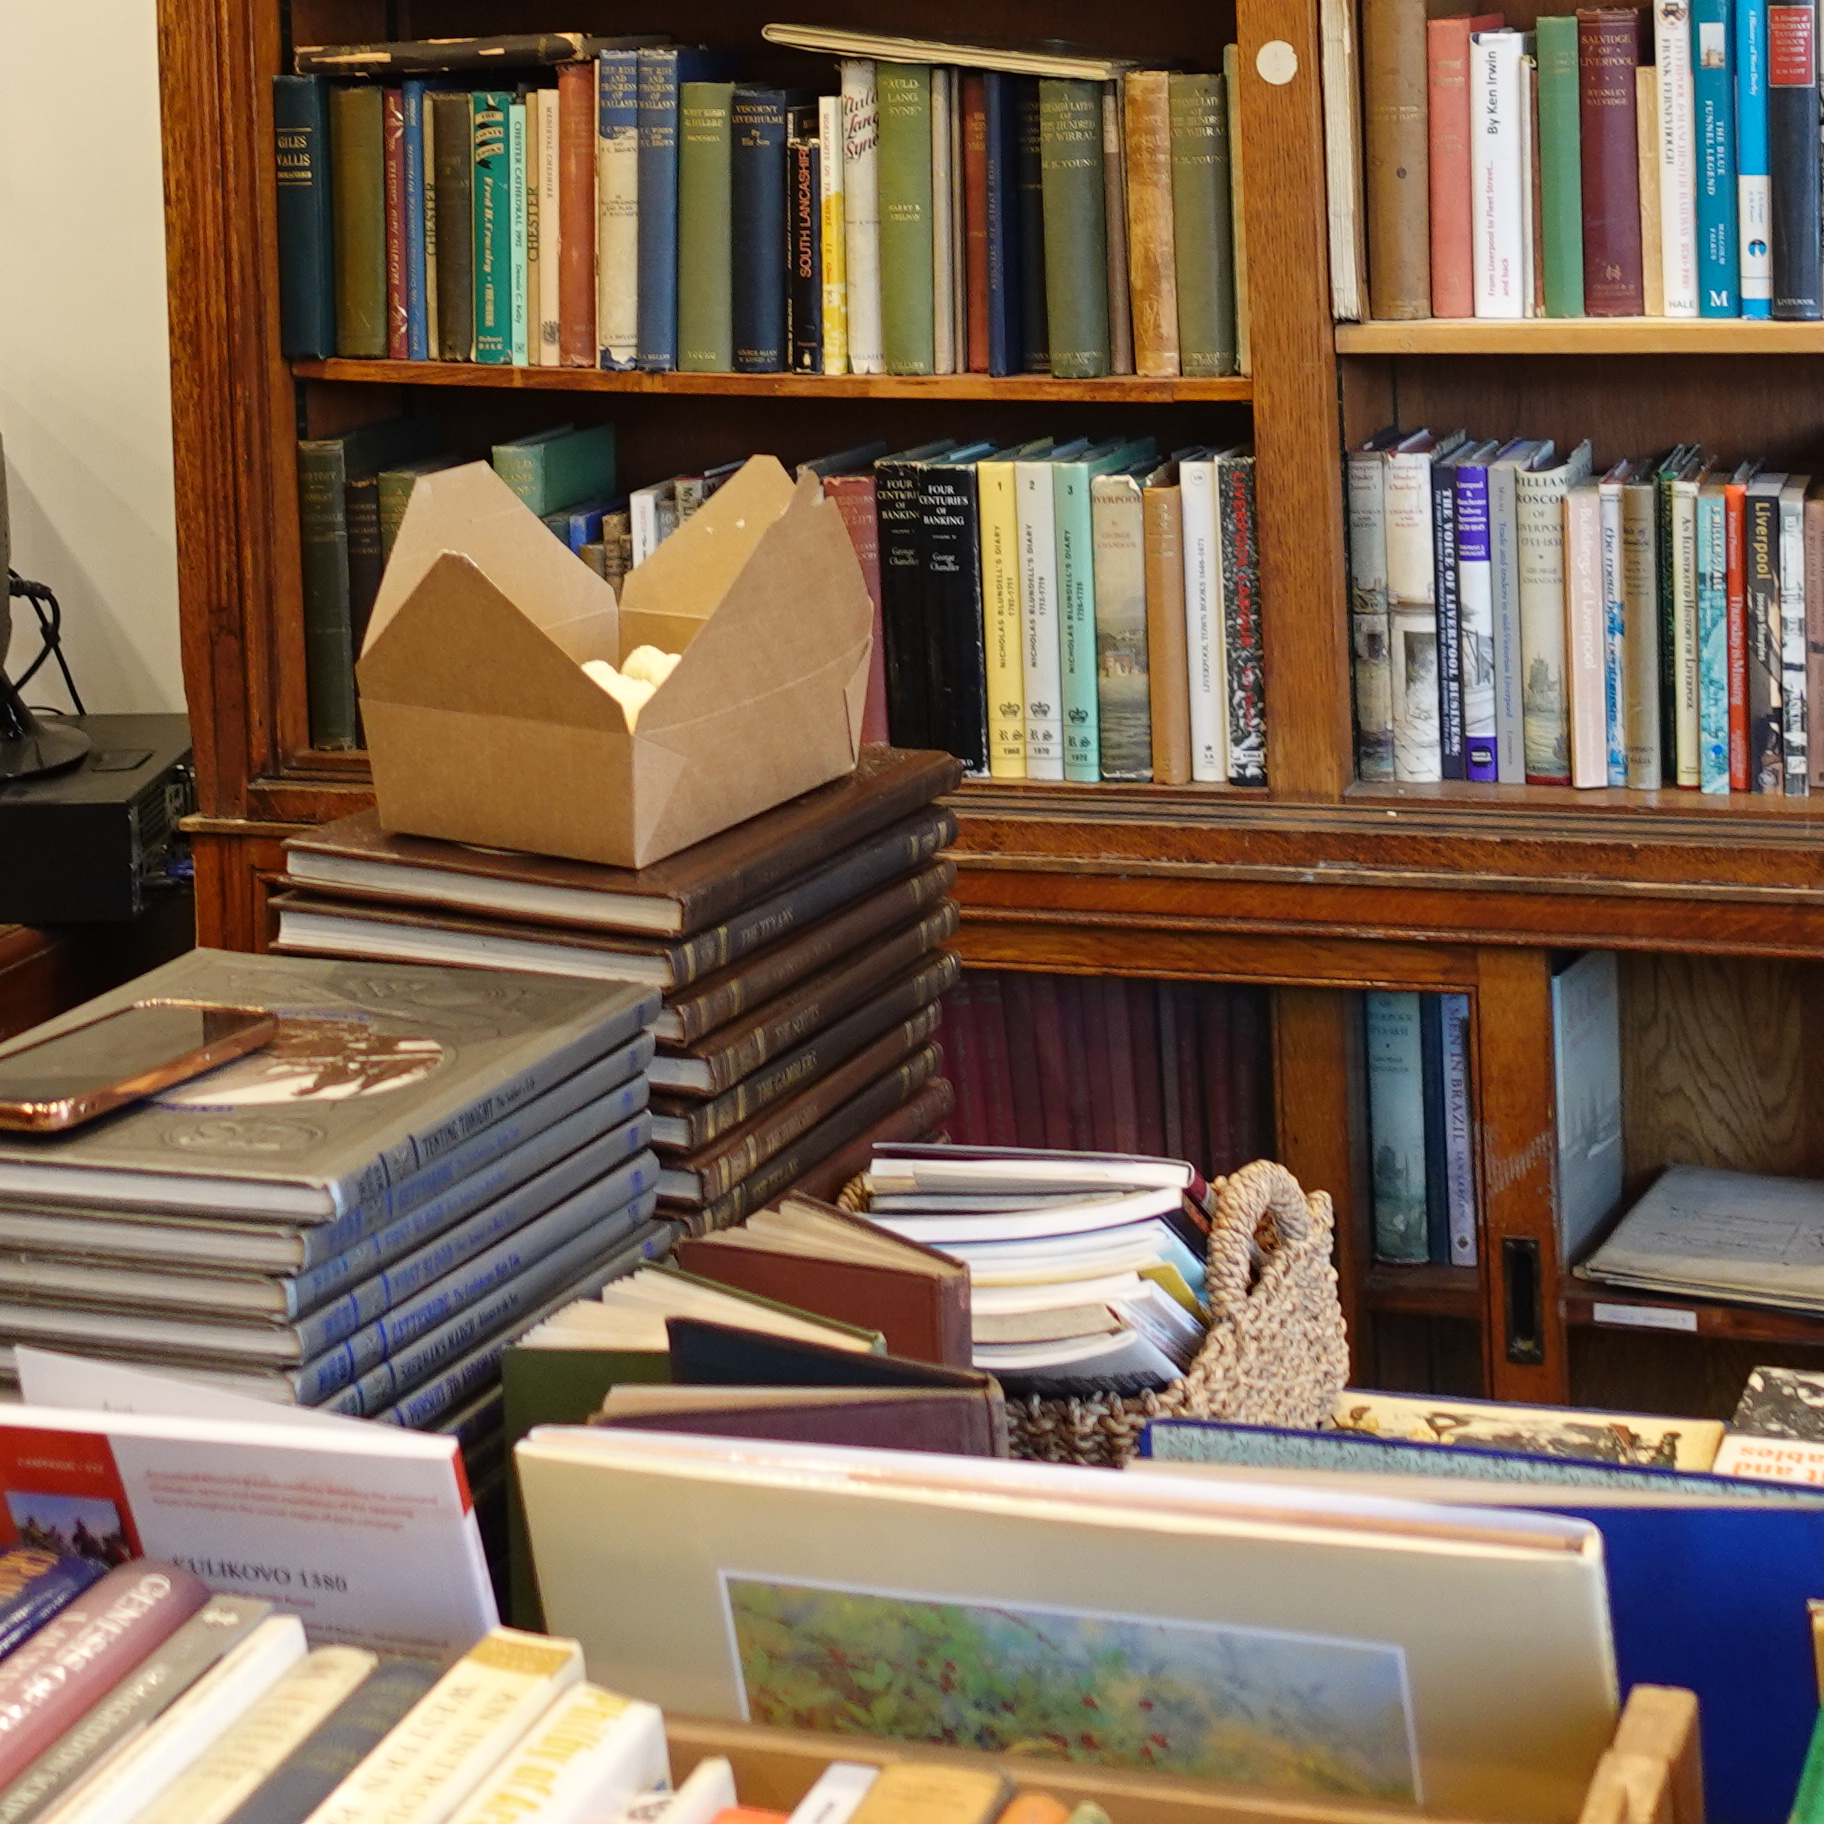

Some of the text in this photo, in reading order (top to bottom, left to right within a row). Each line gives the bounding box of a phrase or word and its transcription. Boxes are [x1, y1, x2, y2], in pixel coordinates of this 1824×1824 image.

[1716, 121, 1725, 176] THE BLUE
[528, 187, 539, 262] CHESTER
[800, 228, 813, 279] SOUTH
[1669, 300, 1694, 310] HALE
[887, 479, 913, 490] FOUR
[928, 485, 955, 496] FOUR
[919, 496, 969, 506] CENTURIES
[1233, 472, 1246, 556] LIVERPOOL
[923, 514, 965, 526] BANKING
[993, 525, 1001, 555] DIARY
[1024, 523, 1033, 553] DIARY
[1064, 530, 1072, 560] DIARY
[1755, 502, 1770, 581] Liverpool
[1442, 489, 1459, 680] THE VOICE OF LIVERPOOL
[1732, 1461, 1794, 1477] and
